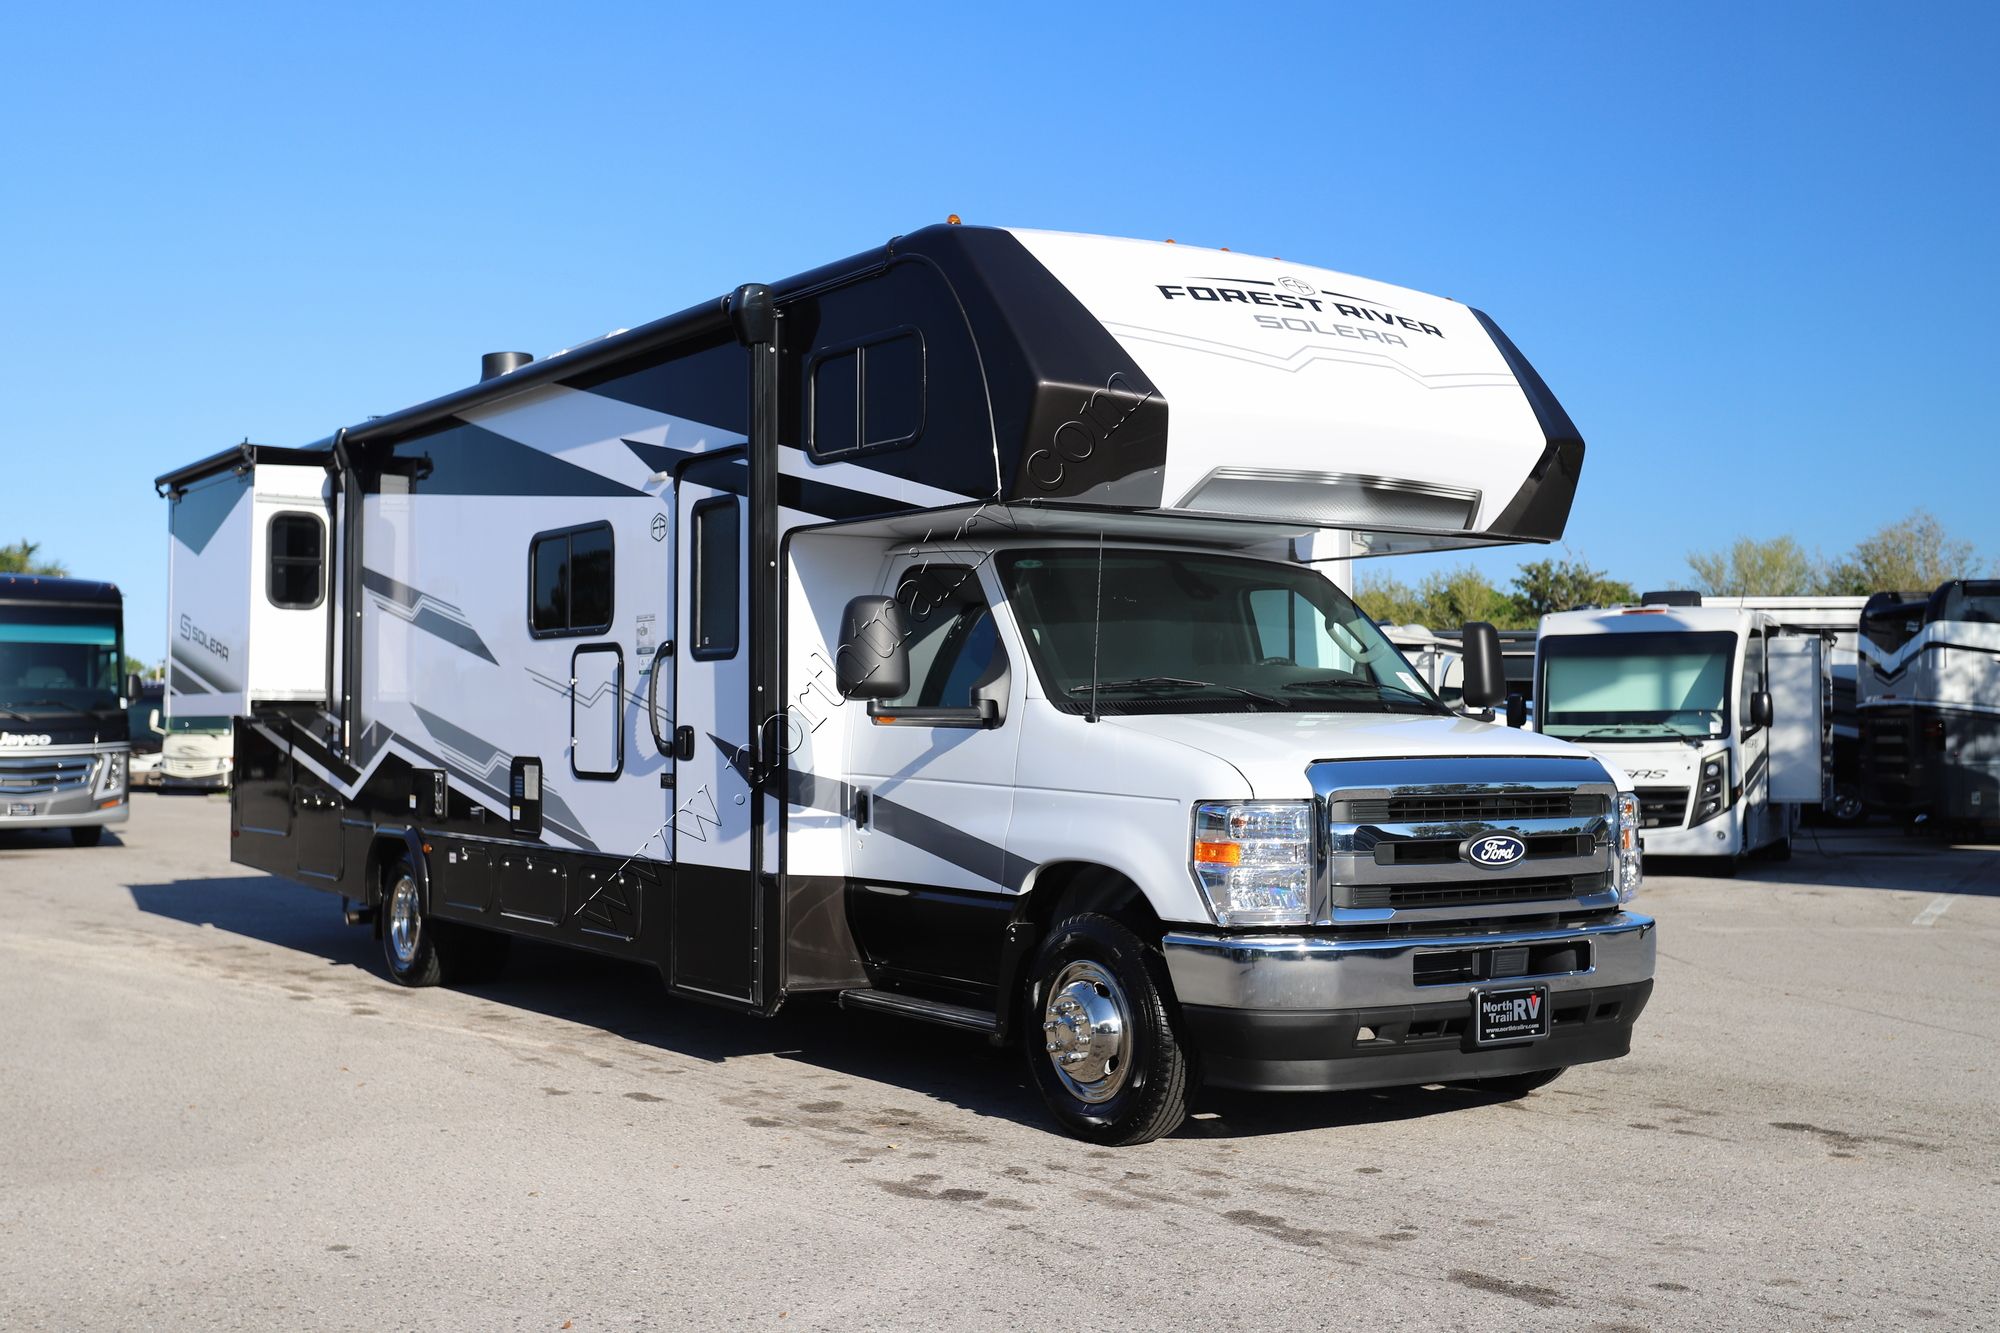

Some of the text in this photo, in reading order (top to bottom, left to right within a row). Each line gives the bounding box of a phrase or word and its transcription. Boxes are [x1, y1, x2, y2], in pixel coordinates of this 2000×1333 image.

[1155, 284, 1446, 339] FOREST RIVER
[1253, 314, 1409, 348] SOLERA
[192, 626, 229, 662] SOLERA
[1481, 840, 1515, 860] Ford
[1483, 1000, 1512, 1013] North
[1488, 1011, 1512, 1023] Trail
[1513, 996, 1541, 1021] RV
